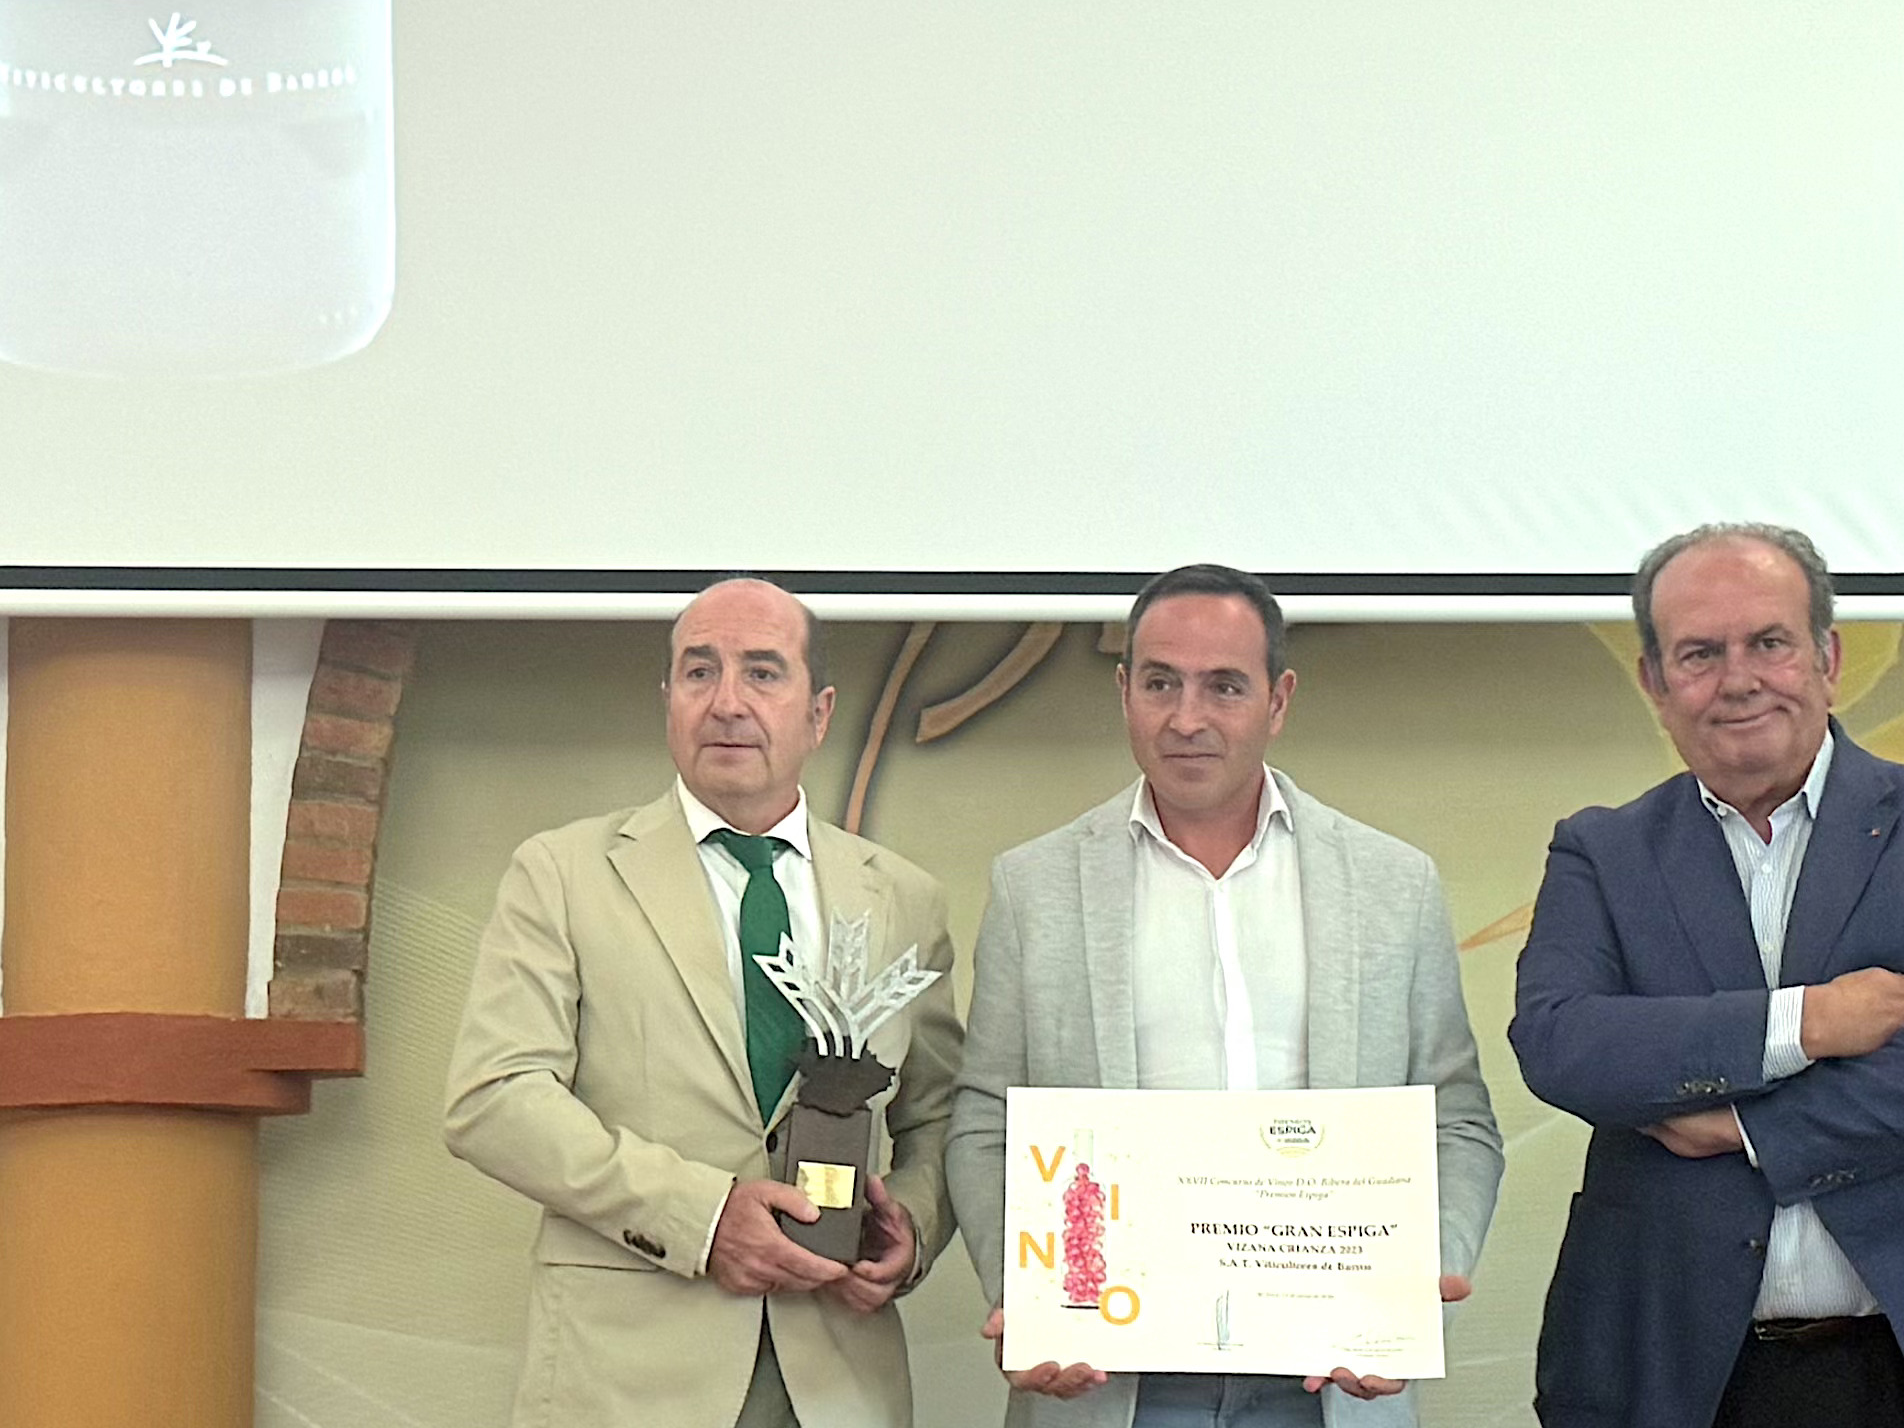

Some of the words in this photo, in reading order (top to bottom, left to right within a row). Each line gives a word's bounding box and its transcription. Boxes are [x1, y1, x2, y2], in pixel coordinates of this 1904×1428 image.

[1191, 1222, 1259, 1235] PREMIO
[1226, 1241, 1277, 1253] VIZANA
[1279, 1243, 1337, 1254] CRIANZA
[1321, 1260, 1333, 1271] de
